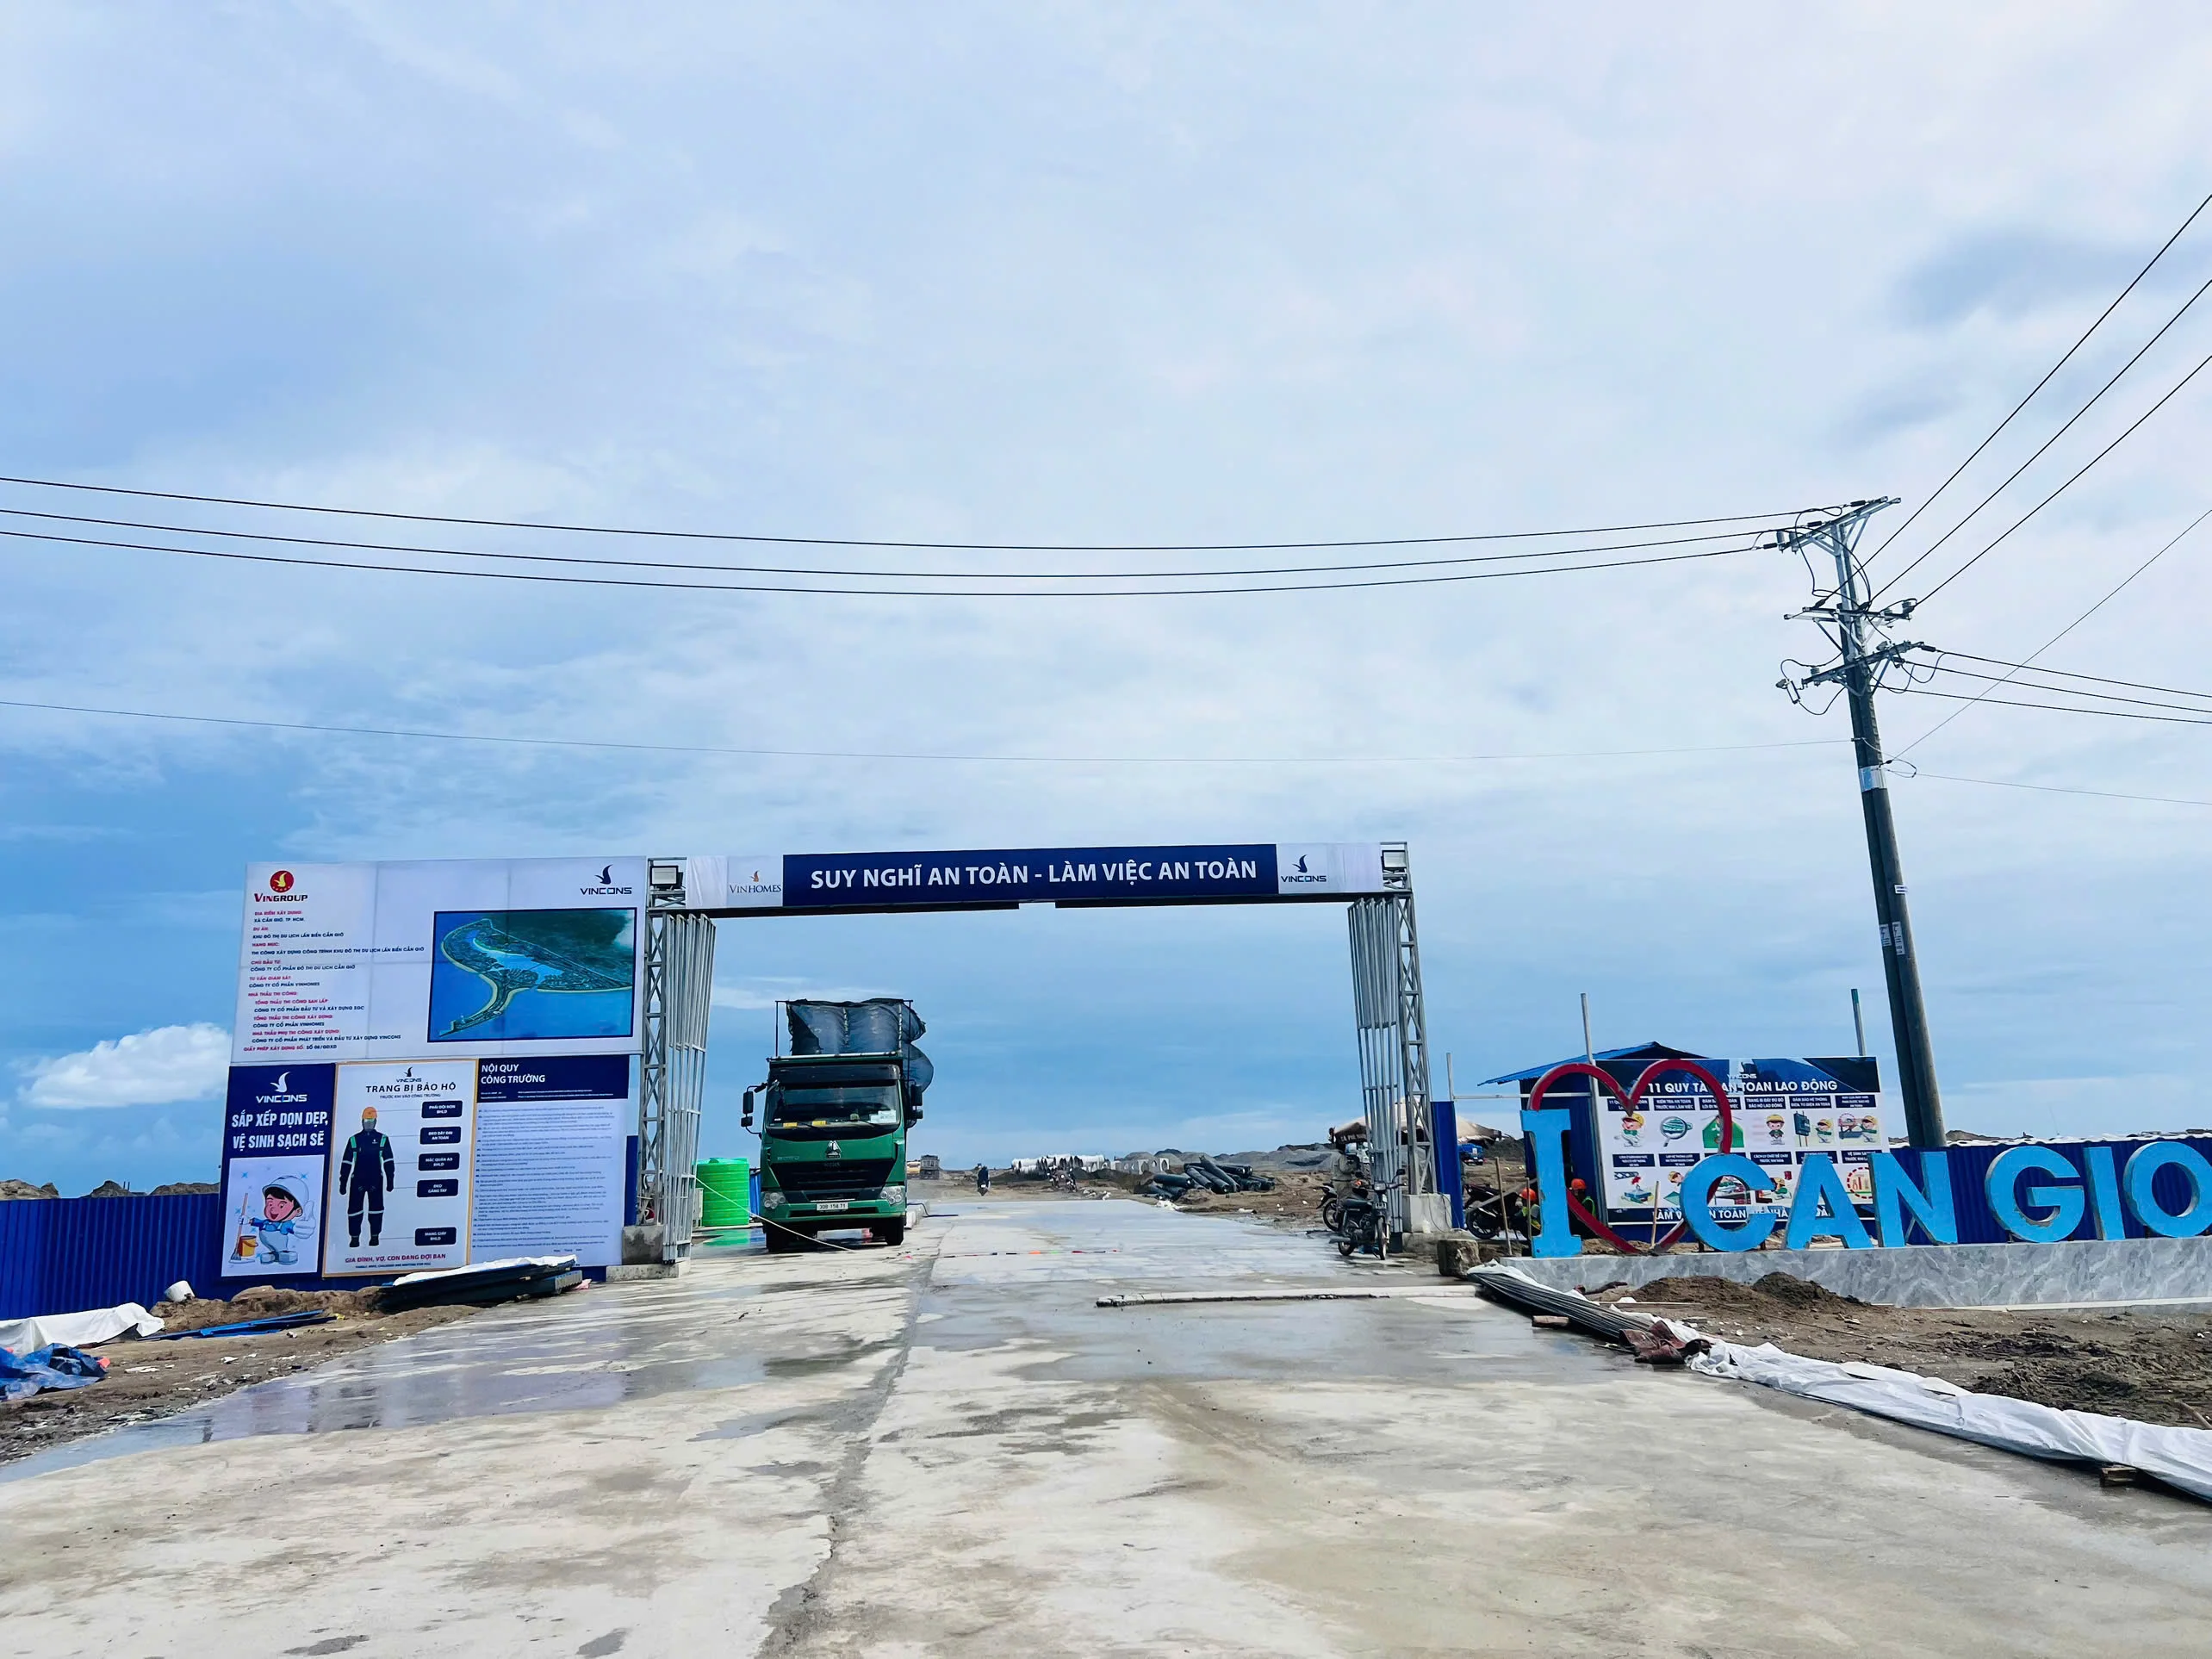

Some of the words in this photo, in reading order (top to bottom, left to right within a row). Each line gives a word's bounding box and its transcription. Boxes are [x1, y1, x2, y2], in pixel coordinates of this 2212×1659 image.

[811, 869, 856, 889] SUY
[863, 864, 921, 887] NGHĨ
[928, 867, 960, 885] AN
[966, 862, 1028, 885] TOÀN
[1048, 861, 1097, 883] LÀM
[1102, 859, 1152, 885] VIỆC
[1159, 861, 1190, 879] AN
[1195, 857, 1257, 879] TOÀN
[1280, 874, 1327, 883] VINCONS
[482, 1063, 497, 1074] NỘI
[499, 1064, 519, 1073] QUY
[481, 1076, 506, 1084] CÔNG
[507, 1074, 545, 1083] TRƯỜNG
[365, 1084, 401, 1093] TRANG
[404, 1084, 413, 1093] BỊ
[417, 1082, 438, 1091] BẢO
[441, 1082, 457, 1091] HỘ
[1648, 1083, 1661, 1093] 11
[1664, 1083, 1690, 1093] QUY
[1775, 1080, 1798, 1091] LAO
[1801, 1078, 1837, 1093] ĐỘNG
[255, 1094, 308, 1103] VINCONS
[232, 1109, 253, 1128] SẮP
[255, 1109, 276, 1127] XẾP
[279, 1112, 302, 1128] DỌN
[305, 1111, 328, 1127] DẸP,
[233, 1134, 245, 1152] VỆ
[248, 1134, 275, 1148] SINH
[277, 1134, 307, 1150] SẠCH
[1519, 1109, 1581, 1258] I
[1679, 1151, 1958, 1253] CAN
[1985, 1140, 2212, 1243] GIO
[1652, 1209, 1673, 1220] ÀM
[1719, 1208, 1746, 1219] TOÀN
